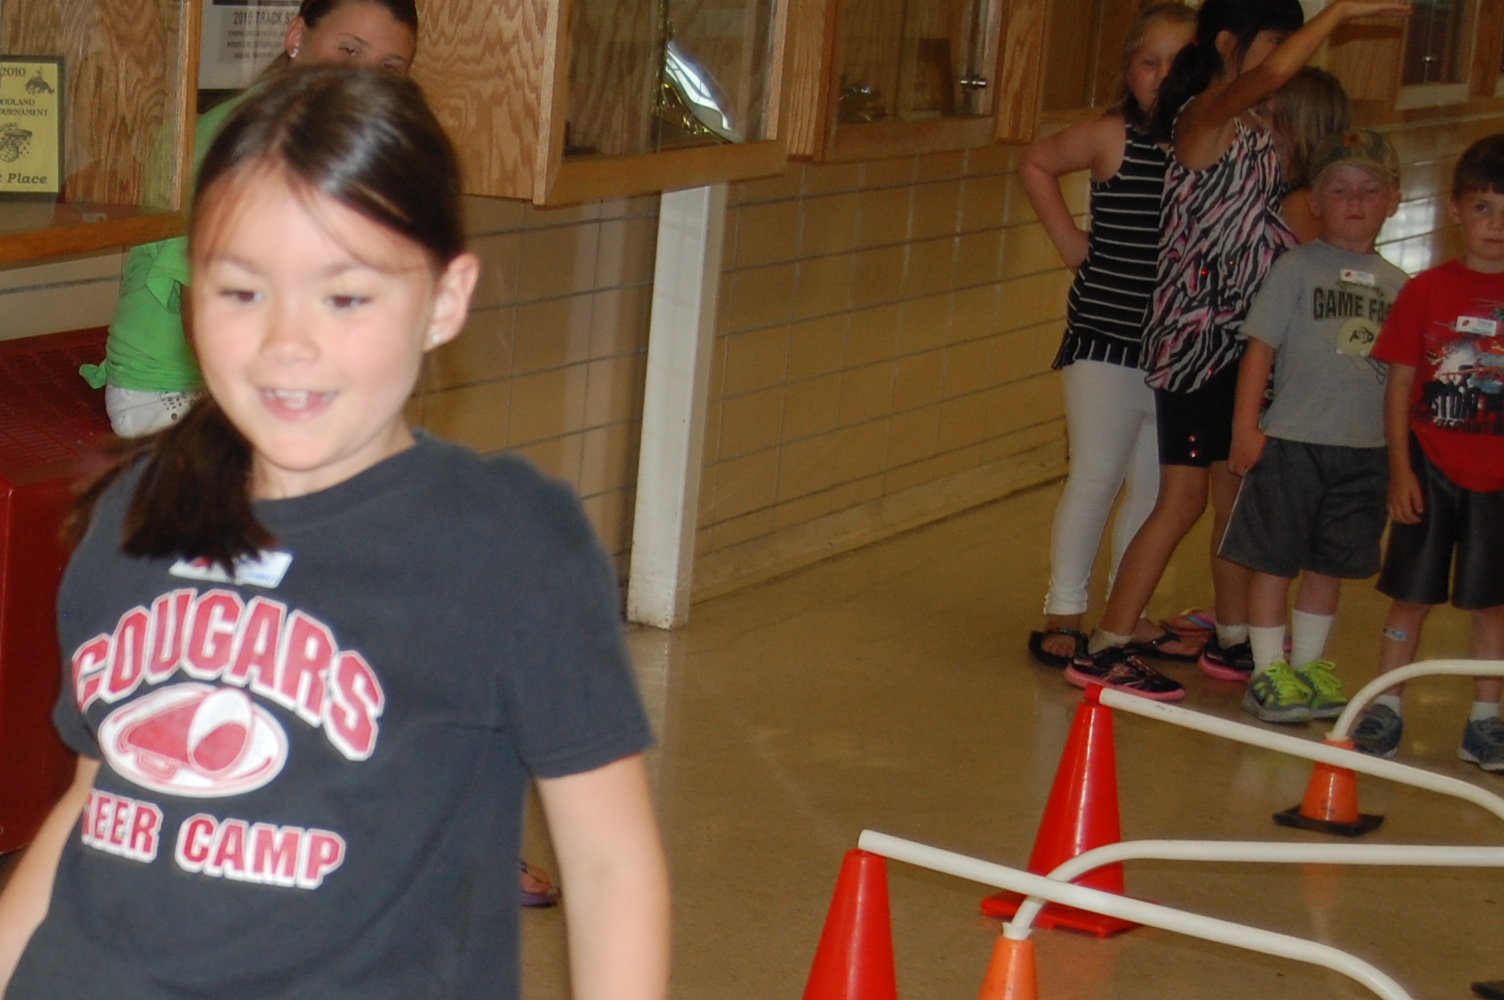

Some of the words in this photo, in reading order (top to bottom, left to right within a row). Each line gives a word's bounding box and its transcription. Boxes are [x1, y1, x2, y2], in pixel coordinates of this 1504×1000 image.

[0, 67, 26, 77] 2010
[7, 172, 47, 184] Place
[1313, 287, 1363, 320] GAME
[72, 588, 385, 762] COUGARS
[175, 813, 346, 890] CAMP
